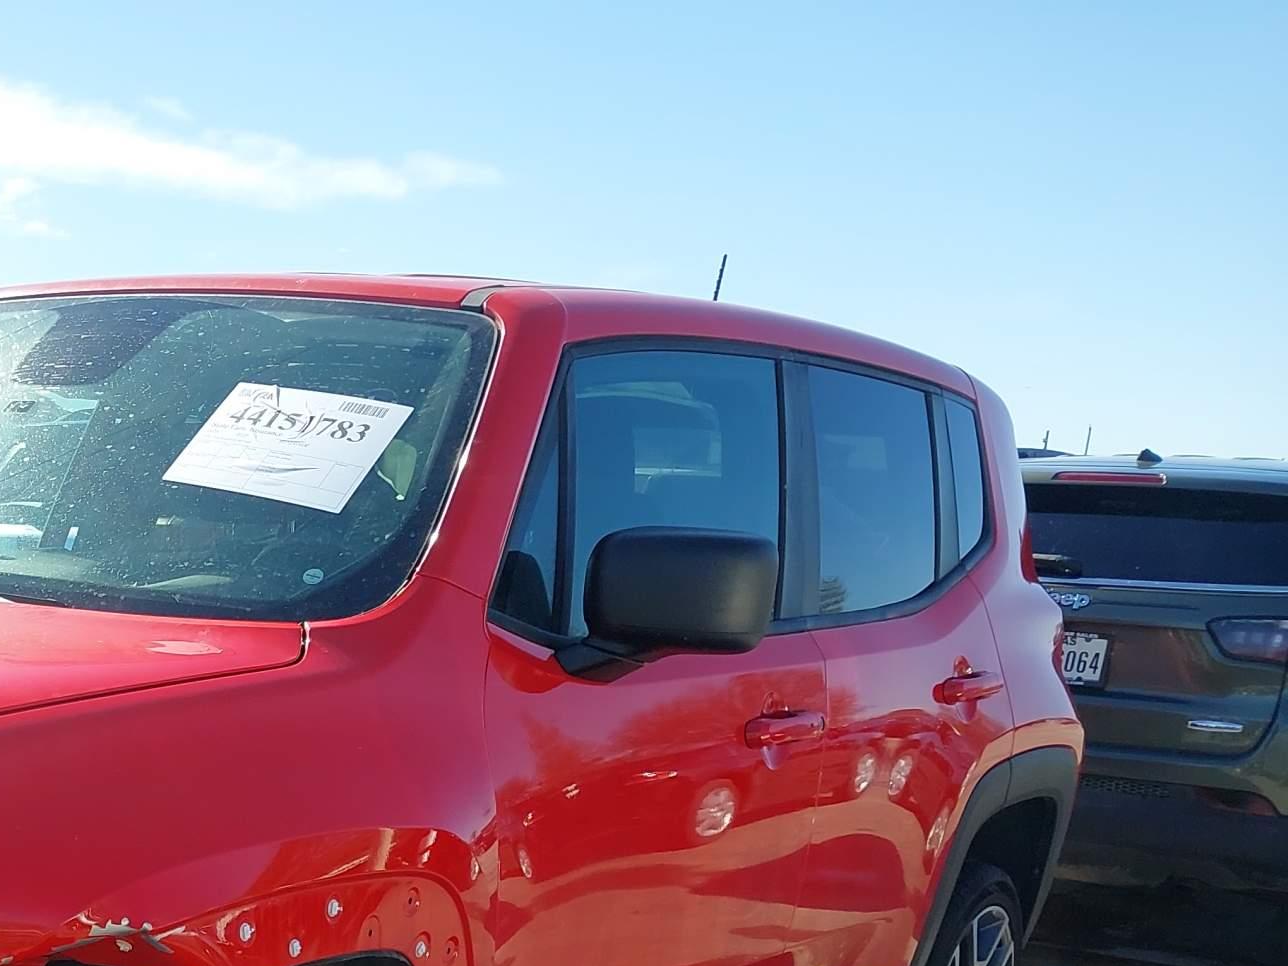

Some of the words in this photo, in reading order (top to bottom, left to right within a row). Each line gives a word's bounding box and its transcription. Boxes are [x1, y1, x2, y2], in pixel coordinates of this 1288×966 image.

[229, 406, 372, 443] 44151783
[1047, 587, 1091, 610] eep
[1062, 650, 1101, 675] 064
